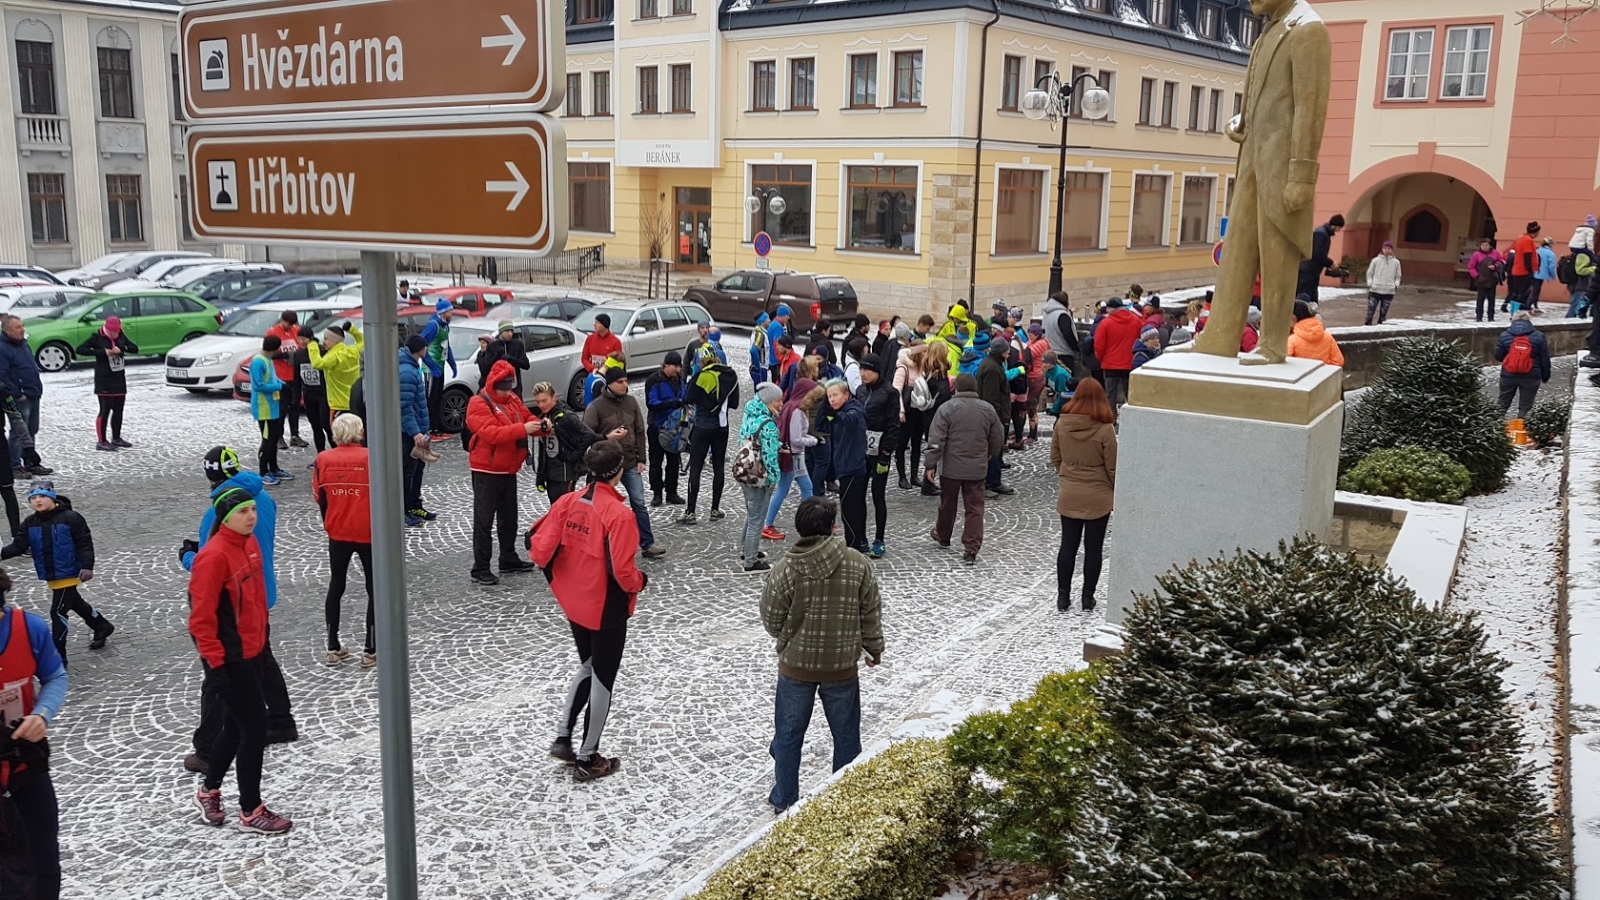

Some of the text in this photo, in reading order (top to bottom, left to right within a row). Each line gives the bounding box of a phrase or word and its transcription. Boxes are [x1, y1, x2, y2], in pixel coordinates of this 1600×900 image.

[240, 22, 404, 91] Hvězdárna
[645, 149, 681, 163] BERÁNEK
[248, 157, 355, 215] Hřbitov
[302, 370, 319, 381] 183
